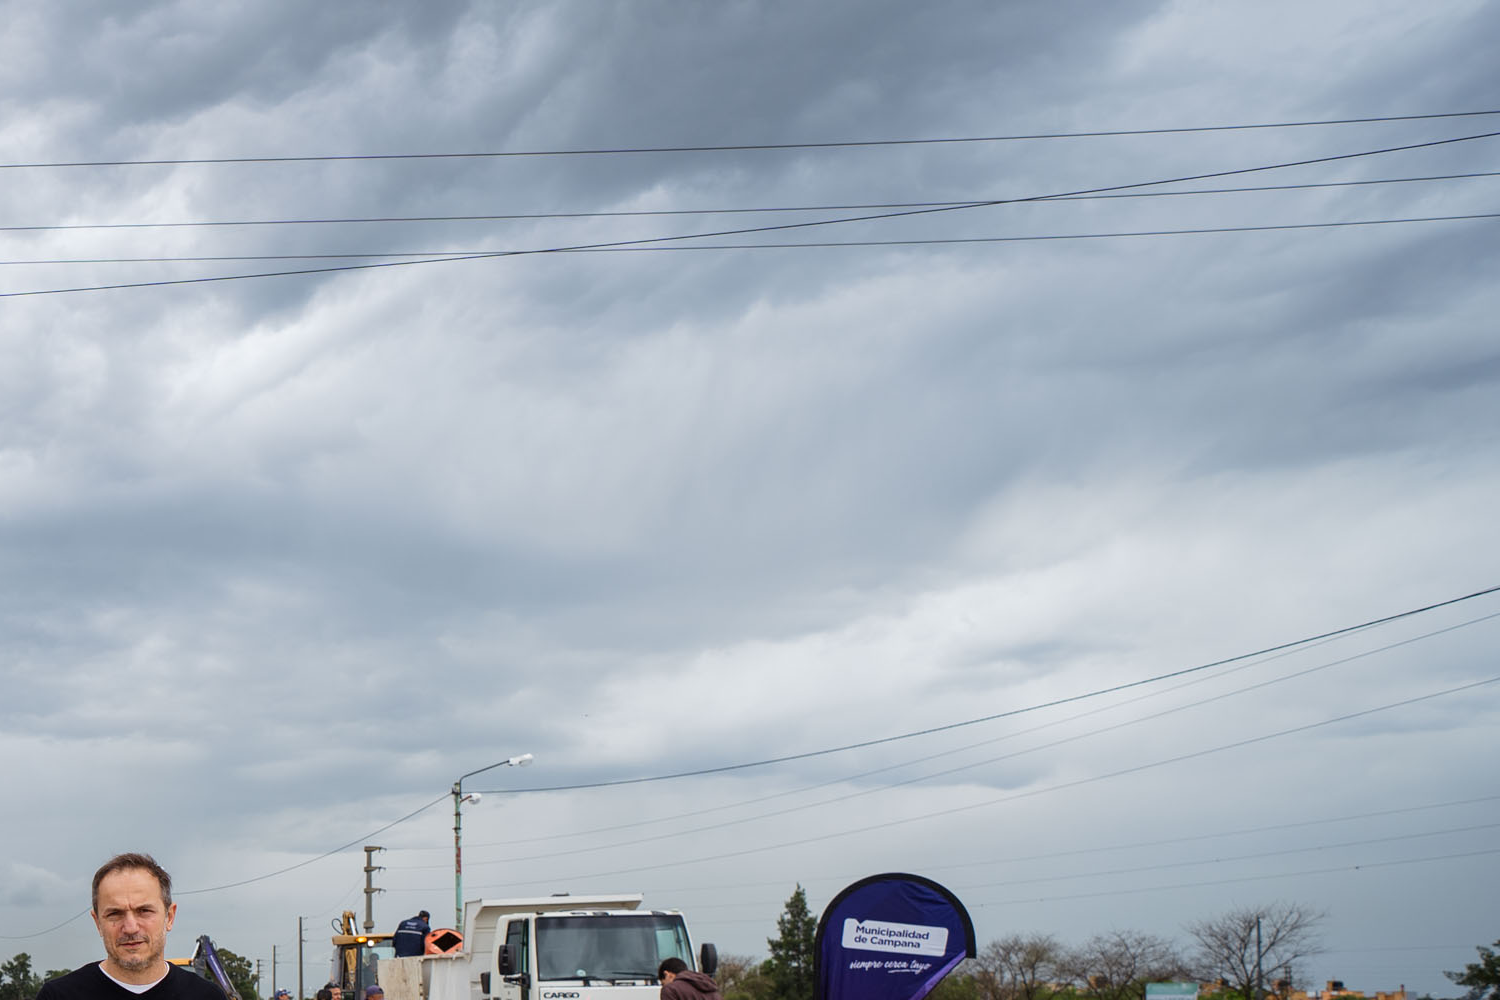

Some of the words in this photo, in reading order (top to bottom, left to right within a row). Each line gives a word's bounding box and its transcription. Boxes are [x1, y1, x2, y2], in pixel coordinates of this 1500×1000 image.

[855, 925, 930, 940] Municipalidad
[853, 935, 868, 944] de
[870, 936, 921, 949] Campana
[849, 960, 883, 972] siempre
[884, 960, 908, 969] cerca
[909, 959, 932, 975] tuyo
